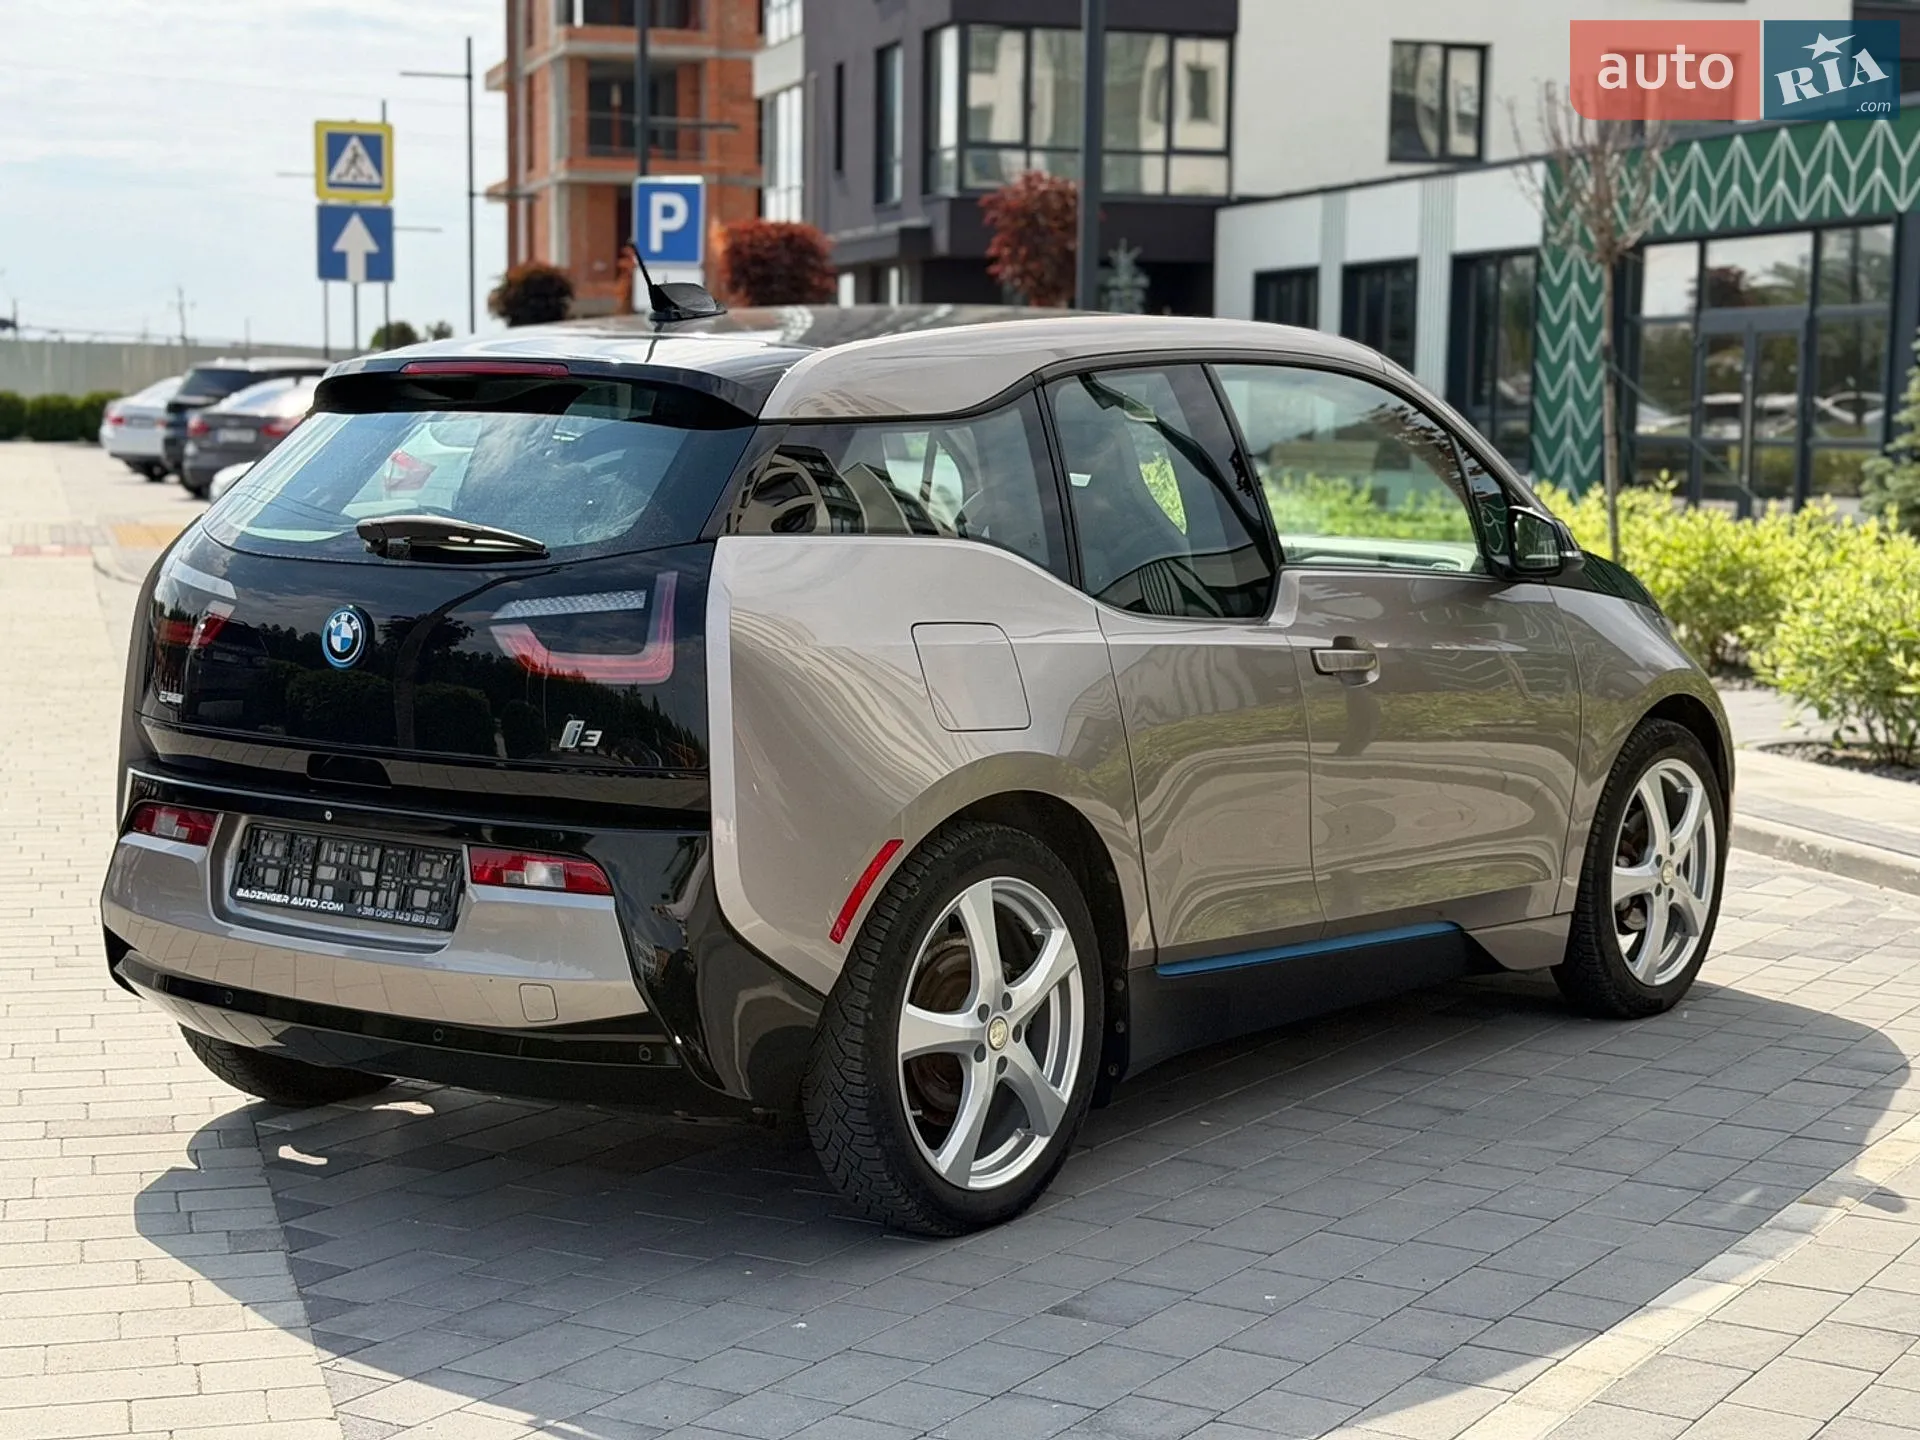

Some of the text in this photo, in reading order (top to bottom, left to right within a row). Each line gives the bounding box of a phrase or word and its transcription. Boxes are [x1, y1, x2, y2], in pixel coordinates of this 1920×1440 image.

[649, 191, 689, 253] P
[329, 612, 359, 630] BMW
[559, 719, 603, 749] i3
[236, 887, 290, 904] BADZINGER
